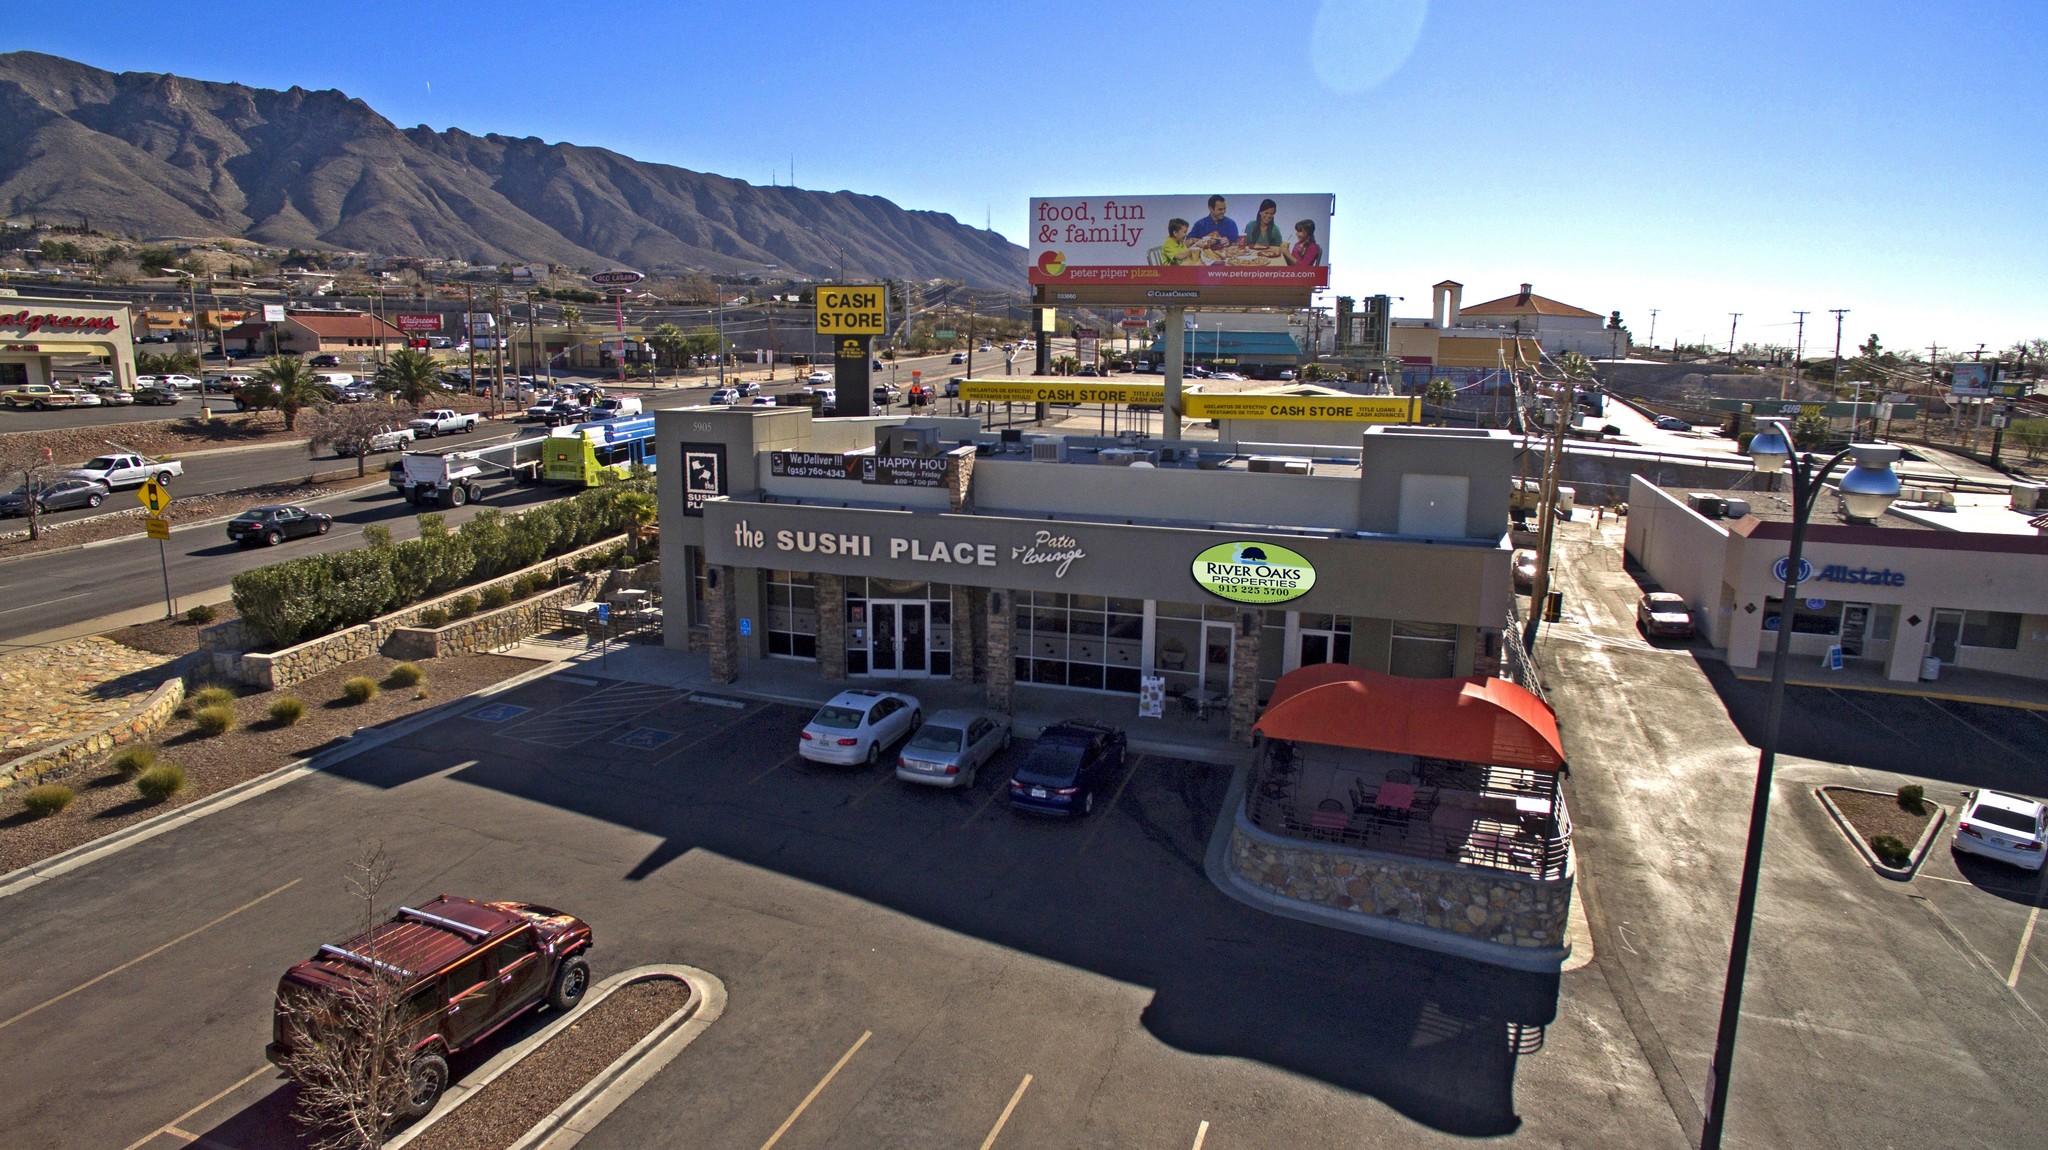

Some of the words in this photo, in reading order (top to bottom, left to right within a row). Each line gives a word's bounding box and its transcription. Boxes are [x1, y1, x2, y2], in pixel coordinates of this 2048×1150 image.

[1038, 202, 1095, 224] food,
[1104, 201, 1145, 220] fun
[1038, 224, 1058, 243] &
[1065, 224, 1143, 247] family
[1070, 268, 1098, 279] peter
[1100, 268, 1128, 279] piper
[1208, 270, 1315, 278] www.peterpiperpizza.com
[826, 294, 876, 308] CASH
[0, 310, 120, 332] algreens
[400, 315, 438, 324] Walgreens
[820, 313, 882, 327] STORE
[1037, 389, 1075, 400] CASH
[1080, 391, 1127, 402] STORE
[1270, 405, 1305, 416] CASH
[1309, 406, 1353, 417] STORE
[1779, 404, 1826, 414] SUBWAY
[692, 422, 712, 432] 5905
[790, 453, 802, 464] We
[804, 454, 832, 466] Deliver
[834, 455, 842, 466] !!!
[878, 457, 916, 469] HAPPY
[920, 459, 947, 470] HOU
[787, 466, 806, 476] (915)
[808, 467, 846, 478] 760-4343
[892, 469, 916, 478] Monday
[921, 471, 941, 479] Friday
[704, 481, 715, 490] the
[687, 501, 704, 509] PLA
[735, 520, 764, 548] the
[777, 530, 871, 556] SUSHI
[890, 538, 997, 566] PLACE
[1035, 530, 1076, 548] Patio
[1022, 548, 1086, 578] lounge
[1207, 562, 1251, 577] RIVER
[1256, 566, 1301, 580] OAKS
[1815, 564, 1905, 587] Allstate
[1212, 576, 1297, 588] PROPERTIES
[1219, 584, 1238, 593] 915
[1241, 586, 1260, 595] 225
[1263, 588, 1289, 596] 5700
